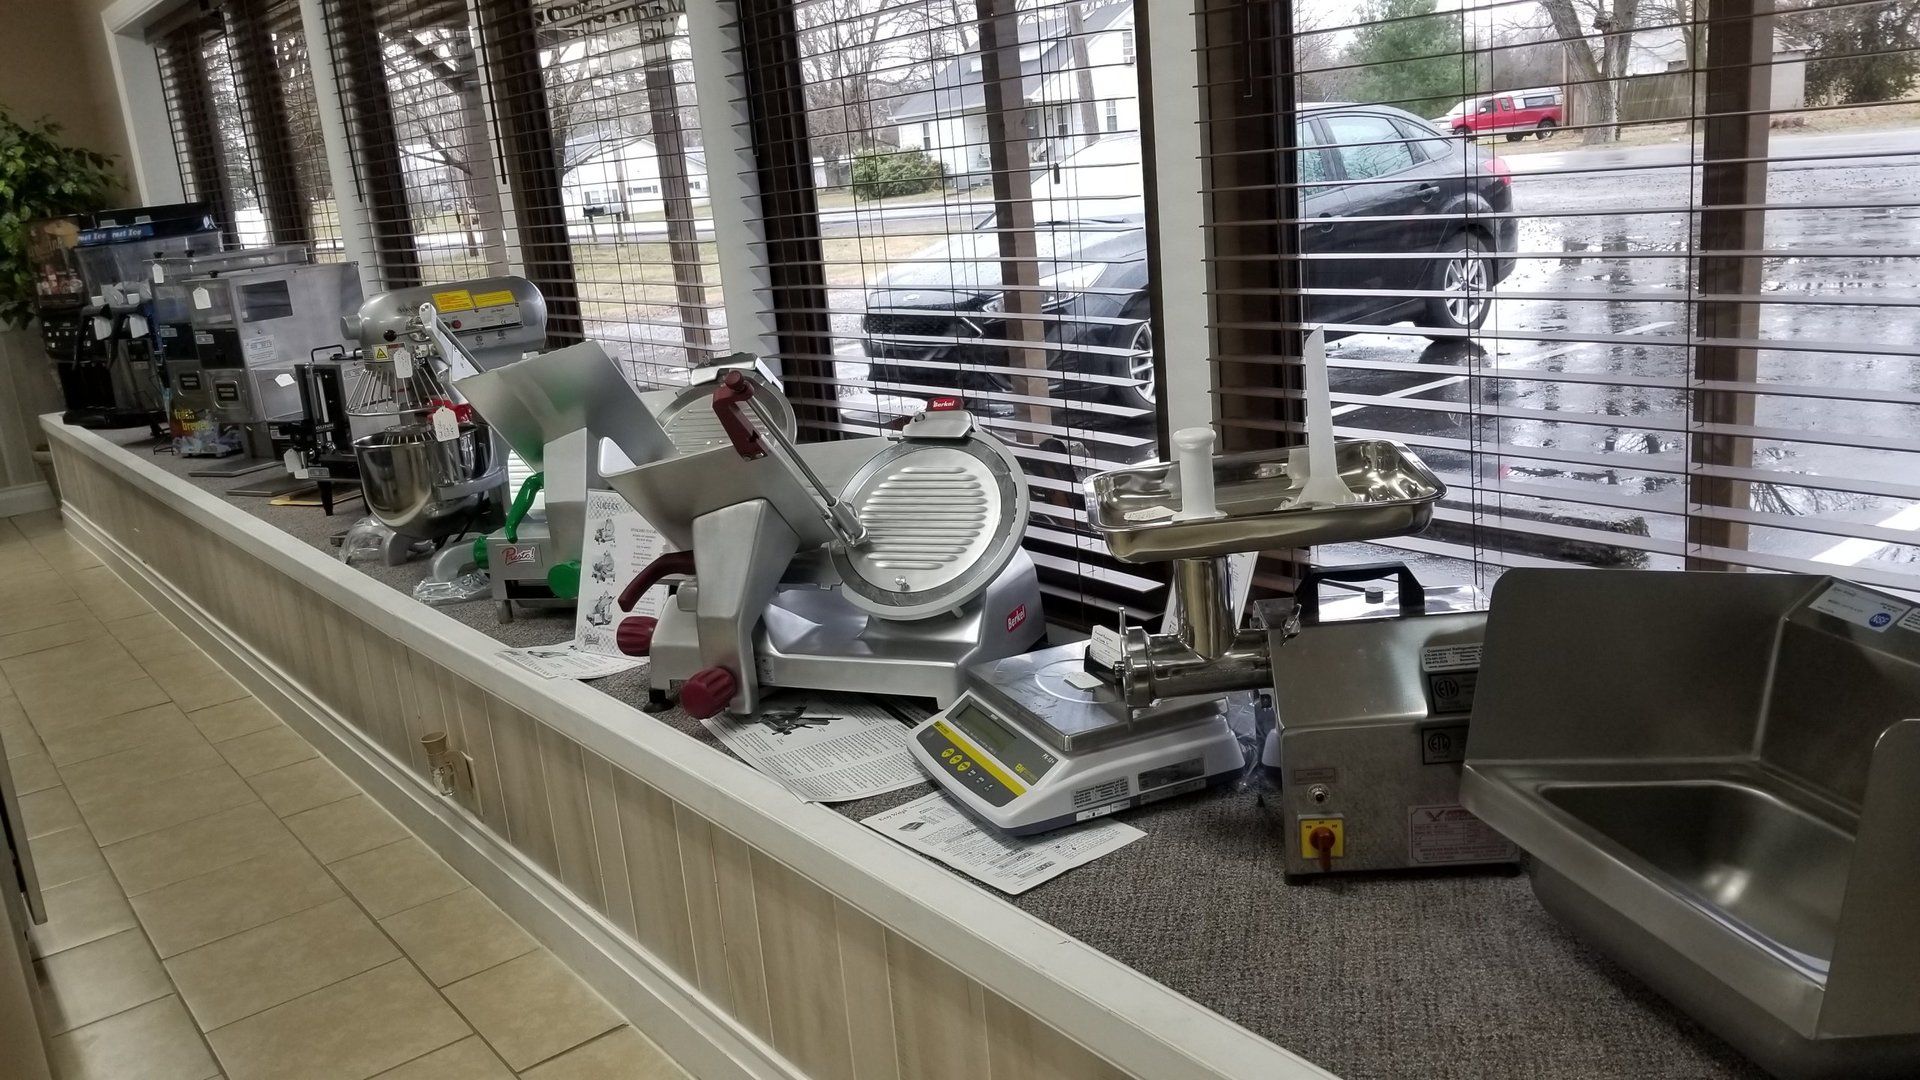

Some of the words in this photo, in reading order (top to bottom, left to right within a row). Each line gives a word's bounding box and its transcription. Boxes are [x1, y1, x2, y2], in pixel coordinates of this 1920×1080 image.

[932, 400, 955, 408] Berkel
[501, 546, 536, 566] Presto!
[1007, 605, 1025, 630] Berkel
